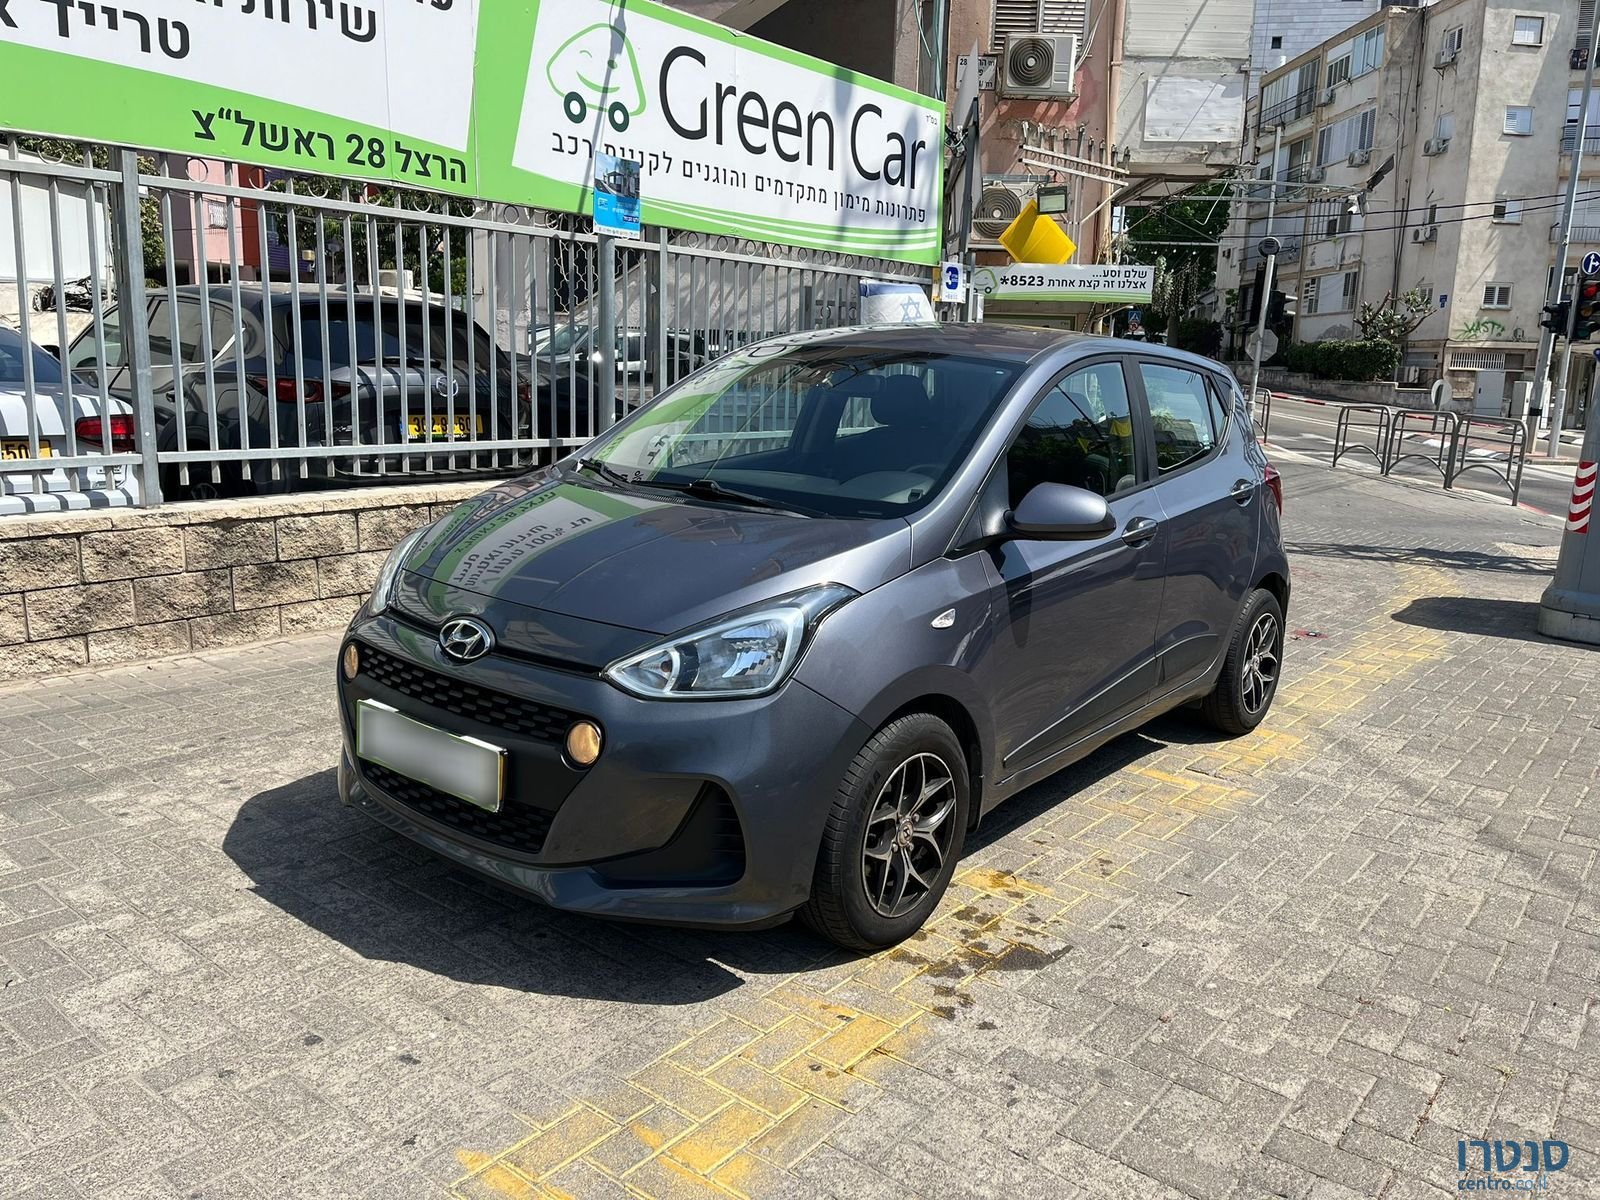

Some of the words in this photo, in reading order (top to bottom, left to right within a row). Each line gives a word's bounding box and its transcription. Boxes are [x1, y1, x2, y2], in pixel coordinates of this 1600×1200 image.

[40, 0, 190, 60] טרייד
[960, 58, 968, 66] 28
[658, 45, 835, 171] Green
[849, 103, 926, 190] Car
[345, 133, 387, 169] 28
[552, 132, 593, 158] רכב
[395, 140, 467, 184] הרצל
[682, 160, 747, 189] והוגנים
[755, 175, 827, 204] מתקדמים
[834, 191, 870, 212] מימון
[875, 199, 926, 223] פתרונות
[1047, 278, 1076, 289] אחרת
[1078, 278, 1100, 291] קצת
[1103, 279, 1116, 289] זה
[1117, 278, 1147, 290] אצלנו
[1124, 268, 1148, 279] שלם
